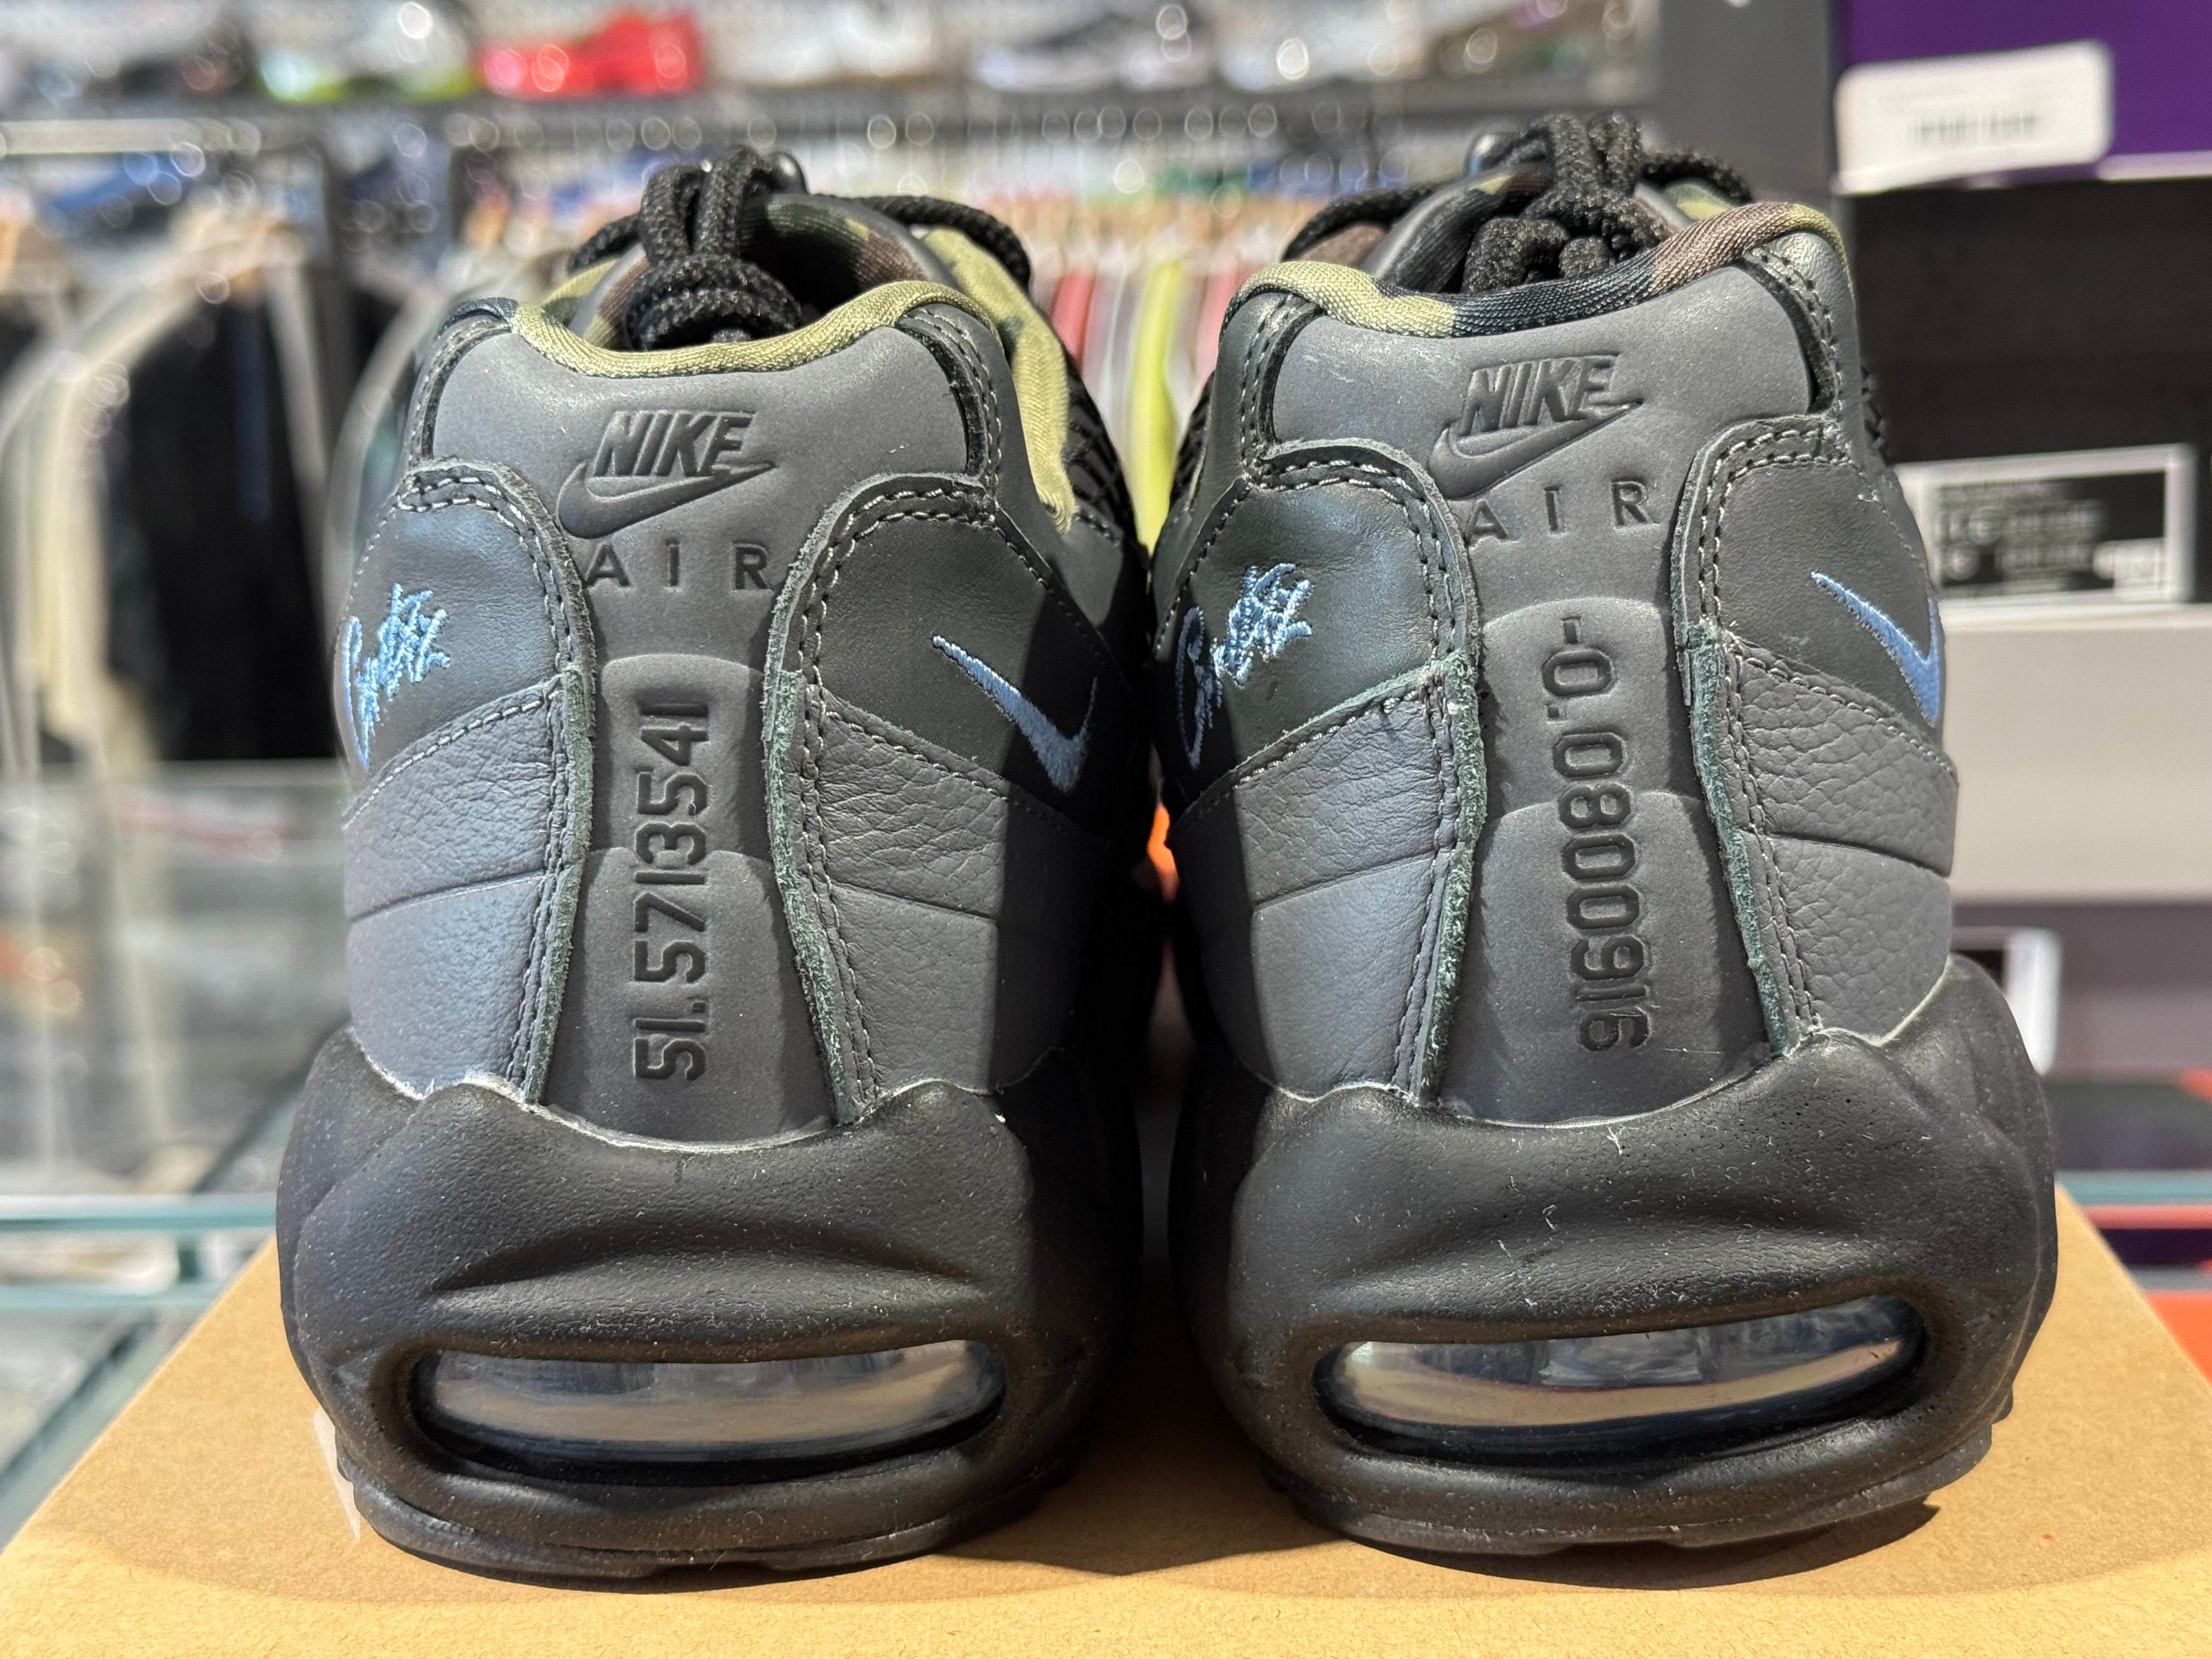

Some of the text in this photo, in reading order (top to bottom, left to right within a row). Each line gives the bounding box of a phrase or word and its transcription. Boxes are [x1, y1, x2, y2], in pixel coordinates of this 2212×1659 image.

[1458, 352, 1620, 437] NIKE
[594, 411, 757, 476] NIKE
[1464, 479, 1650, 546] AIR
[584, 540, 770, 590] AIR
[1541, 617, 1650, 1052] -0.0800916
[634, 703, 709, 1080] 51.5713541
